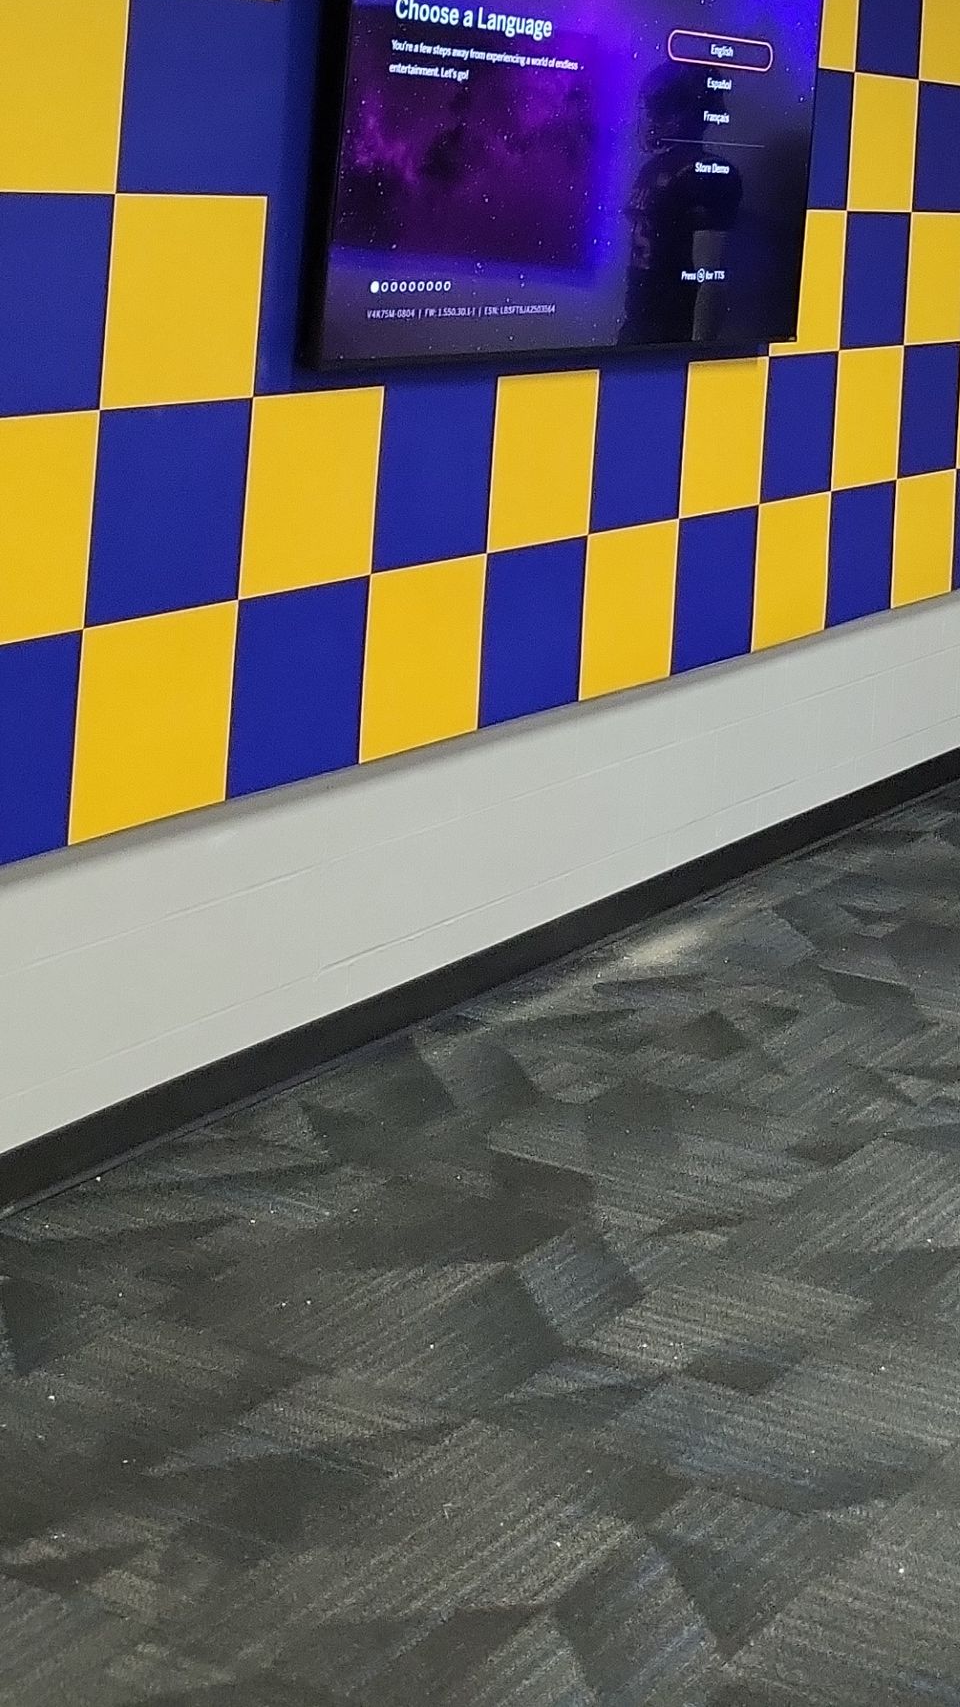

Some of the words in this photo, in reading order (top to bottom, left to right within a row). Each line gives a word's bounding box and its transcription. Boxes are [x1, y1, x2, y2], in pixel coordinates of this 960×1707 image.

[463, 9, 473, 27] a
[478, 7, 553, 41] Language
[391, 39, 413, 52] You're
[413, 44, 419, 53] a
[419, 42, 432, 54] few
[432, 45, 452, 58] steps
[452, 48, 469, 61] away
[469, 48, 486, 60] from
[486, 52, 526, 67] experiencing
[531, 57, 549, 67] world
[548, 57, 556, 68] of
[555, 59, 579, 70] endless
[710, 44, 734, 58] English
[388, 63, 440, 77] entertainment.
[440, 67, 457, 79] Let's
[457, 69, 469, 82] go!
[707, 77, 732, 91] Español
[703, 110, 730, 125] Français
[694, 161, 711, 173] Store
[711, 162, 730, 174] Demo
[681, 270, 697, 280] Press
[705, 270, 714, 280] for
[714, 270, 725, 280] TTS
